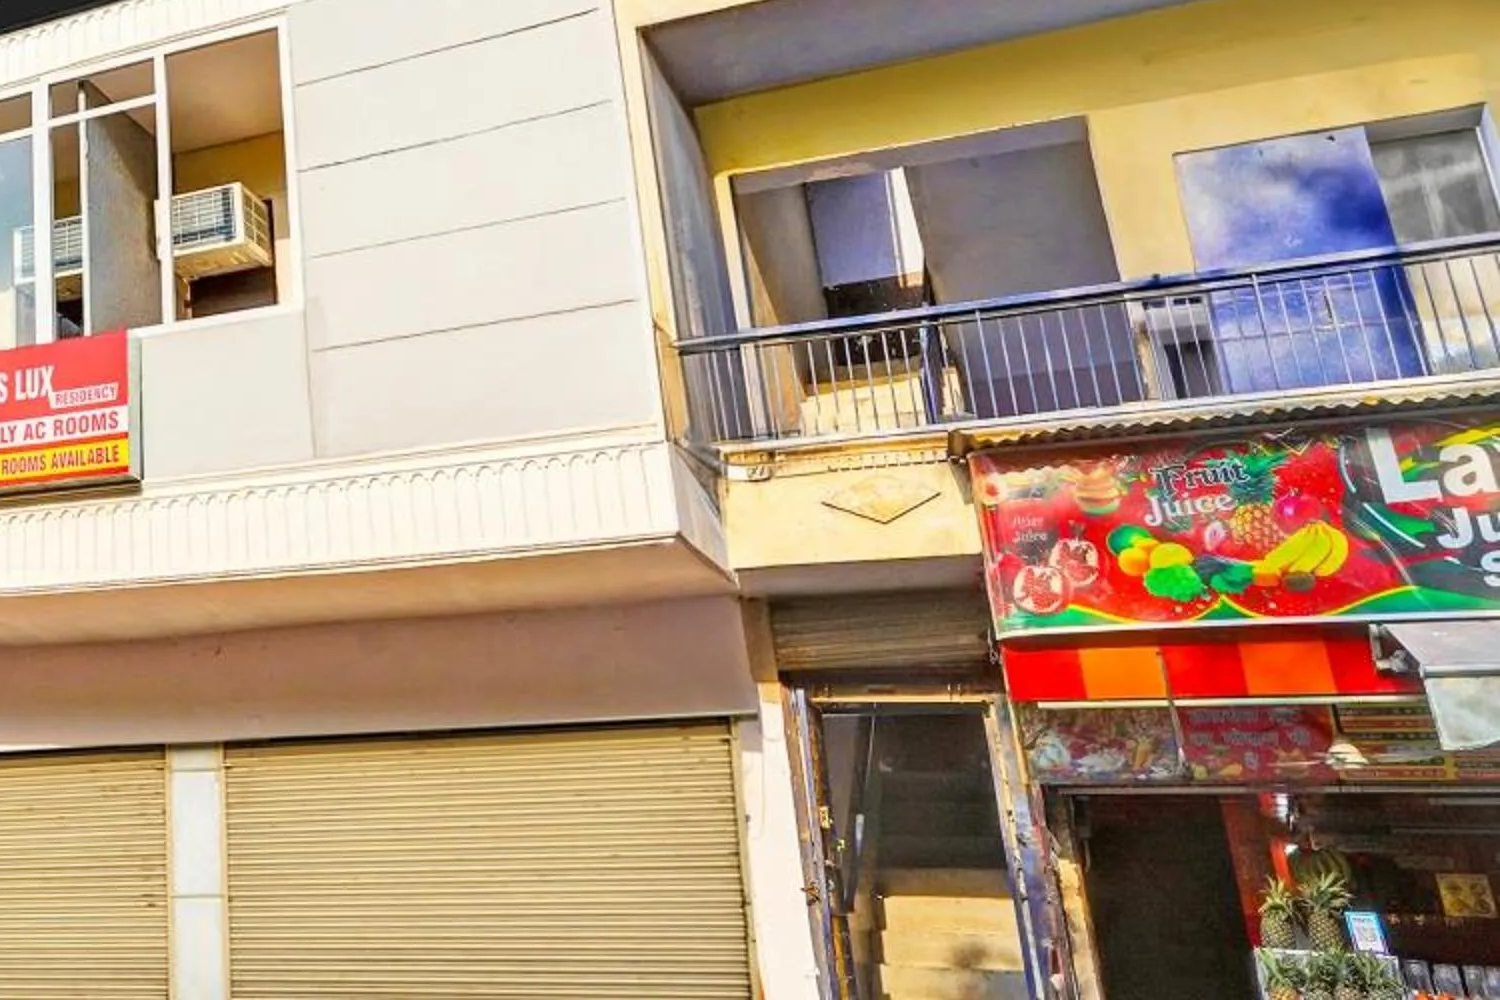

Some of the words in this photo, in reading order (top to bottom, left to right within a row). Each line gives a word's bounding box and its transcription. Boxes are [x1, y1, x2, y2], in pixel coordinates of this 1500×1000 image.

[15, 365, 54, 400] LUX
[55, 385, 117, 406] RESIDENCY
[23, 421, 46, 441] AC
[53, 411, 119, 437] ROOMS
[1, 455, 46, 476] ROOMS
[51, 445, 120, 470] AVAILABLE
[1148, 458, 1250, 499] Fruit
[1145, 493, 1237, 526] Juice
